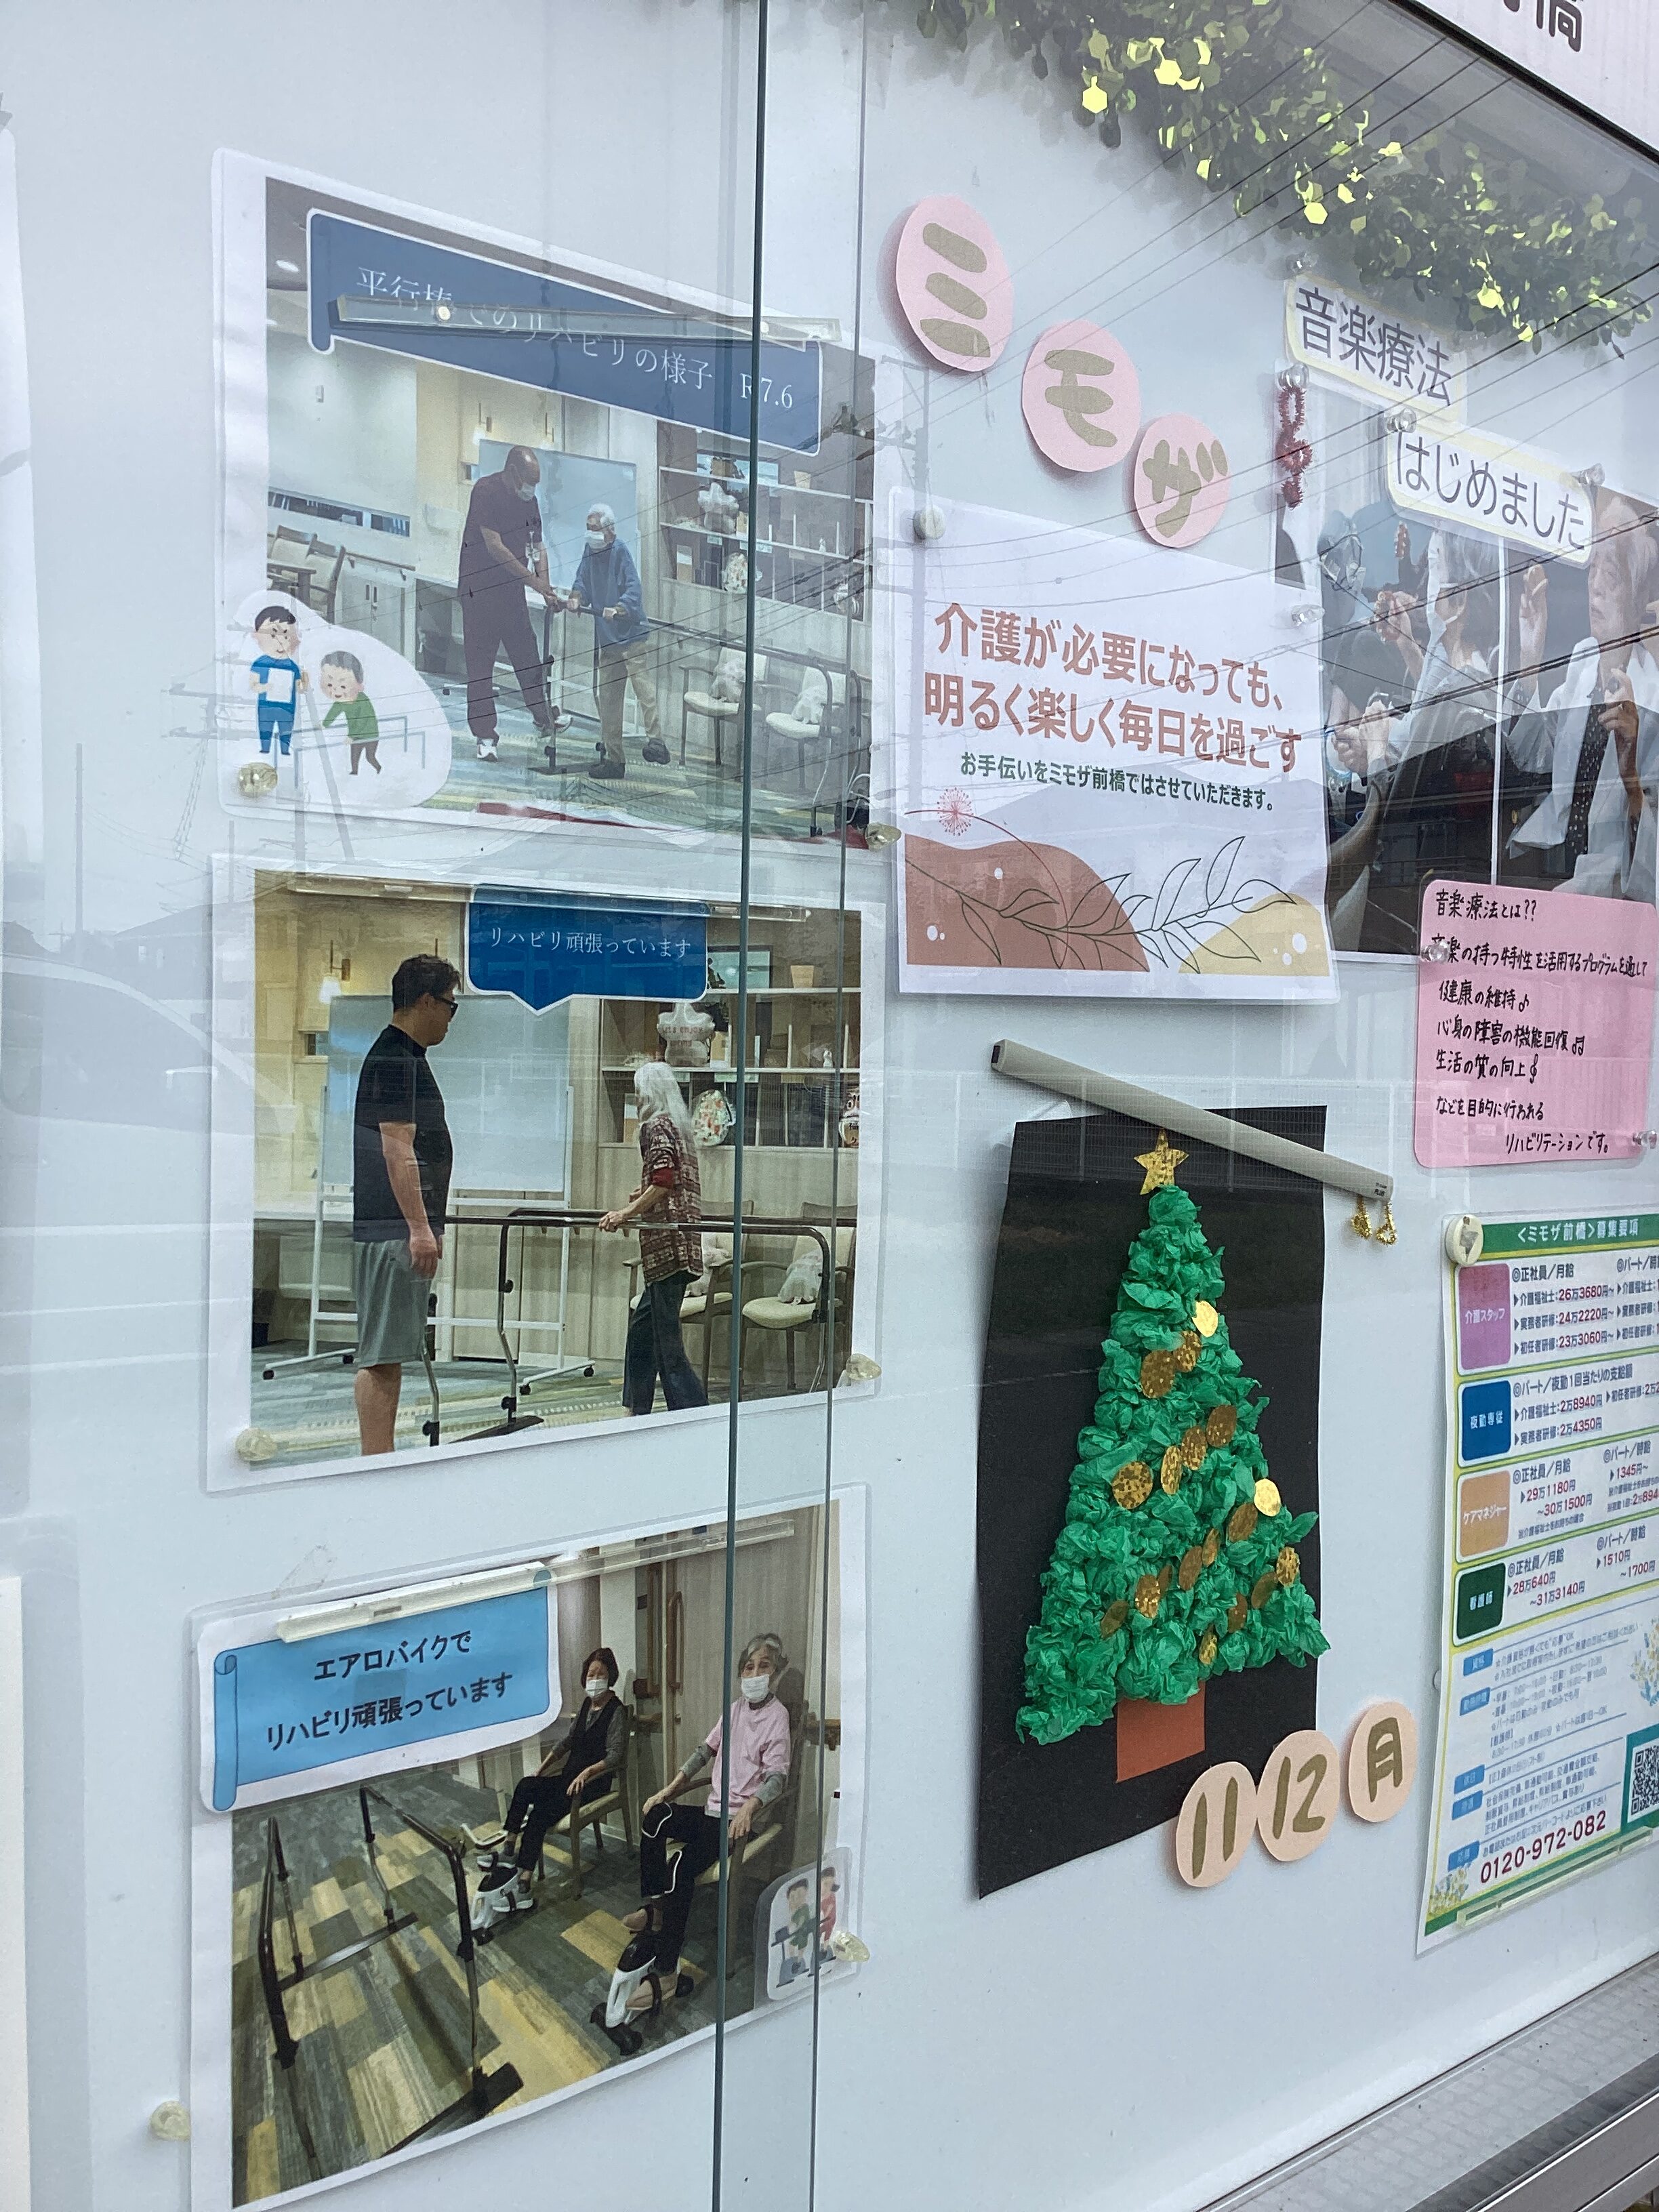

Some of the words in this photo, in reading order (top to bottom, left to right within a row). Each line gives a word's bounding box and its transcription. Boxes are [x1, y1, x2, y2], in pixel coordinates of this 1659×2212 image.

[1296, 287, 1452, 406] 音楽療法
[1397, 432, 1585, 551] はじめました
[934, 602, 1284, 712] 介護が必要になっても、
[924, 671, 1302, 772] 明るく楽しく毎日を過ごす
[960, 751, 1274, 811] お手伝いをミモザ前橋ではさせていただきます。
[491, 926, 691, 959] リハビリ頑張っています
[1436, 1095, 1544, 1121] などを目的に行われる
[1506, 1131, 1609, 1154] リハビリテーションです。
[314, 1630, 472, 1681] エアロバイクで
[267, 1671, 514, 1751] リハビリ頑張っています
[1480, 1809, 1607, 1884] 0120-972-082
